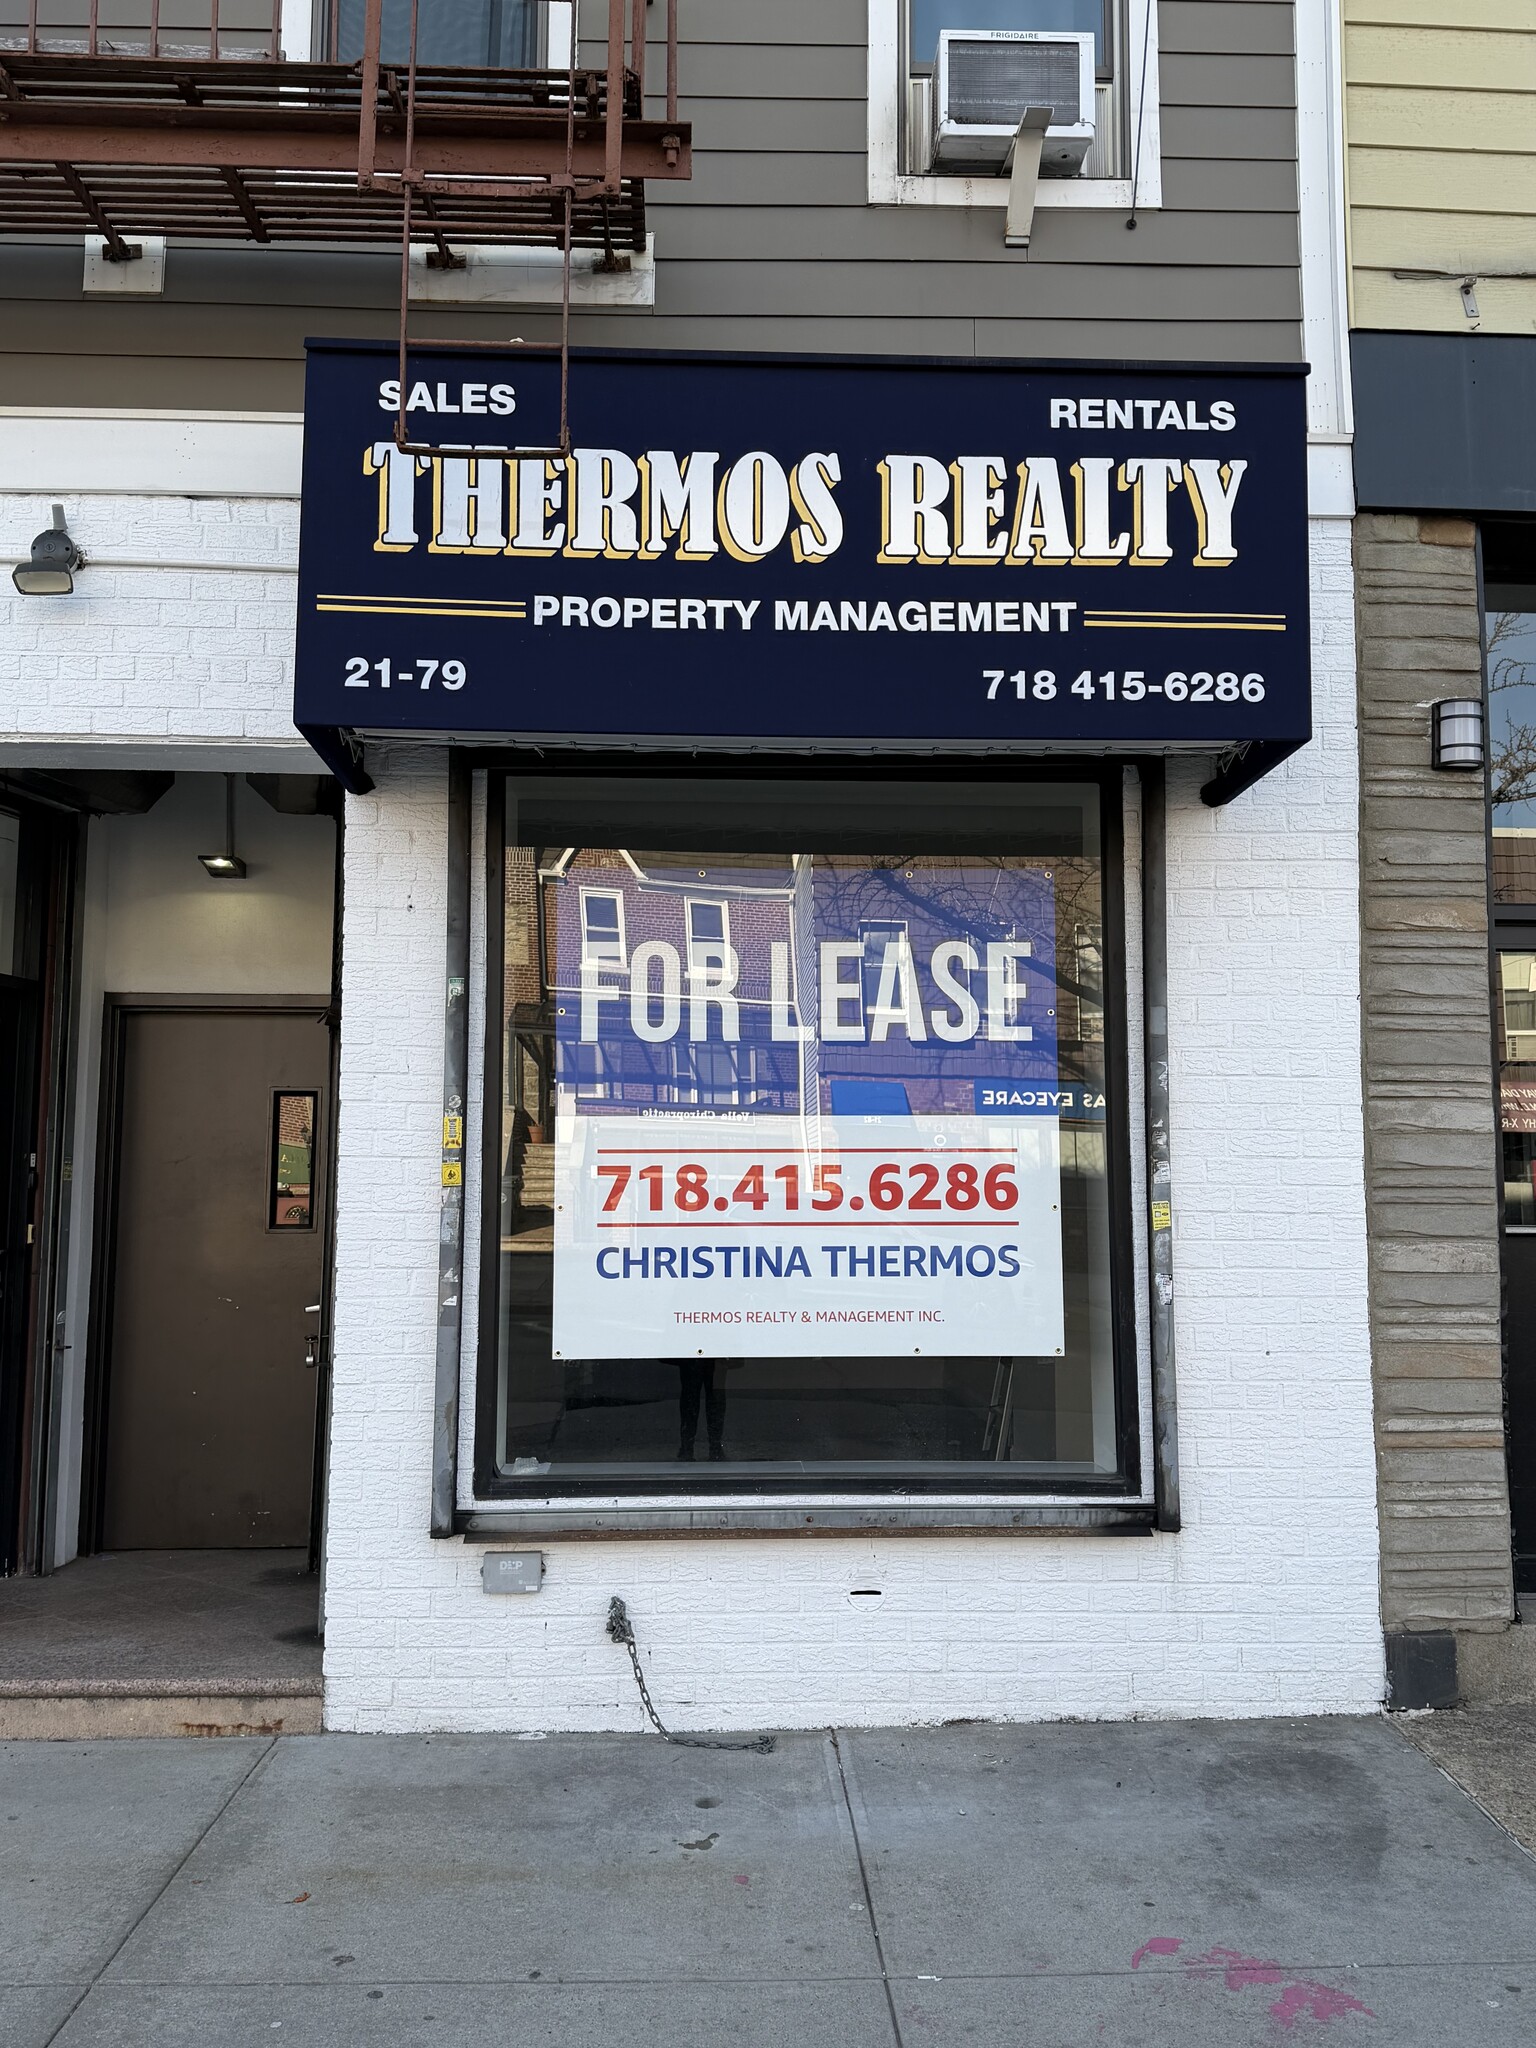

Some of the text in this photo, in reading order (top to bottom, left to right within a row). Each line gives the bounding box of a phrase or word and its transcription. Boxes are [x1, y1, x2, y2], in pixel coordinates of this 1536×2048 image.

[990, 31, 1040, 40] FRIGIDAIRE
[378, 380, 516, 415] SALES
[1050, 398, 1236, 432] RENTALS
[362, 441, 1248, 567] THERMOS REALTY
[533, 595, 1077, 632] PROPERTY MANAGEMENT
[344, 656, 467, 691] 21-79
[982, 669, 1266, 703] 718 415-6286
[580, 940, 1033, 1043] FOR LEASE
[598, 1163, 1019, 1212] 718.415.6286
[596, 1244, 1021, 1279] CHRISTINA THERMOS
[673, 1310, 945, 1324] THERMOS REALTY & MANAGEMENT INC.
